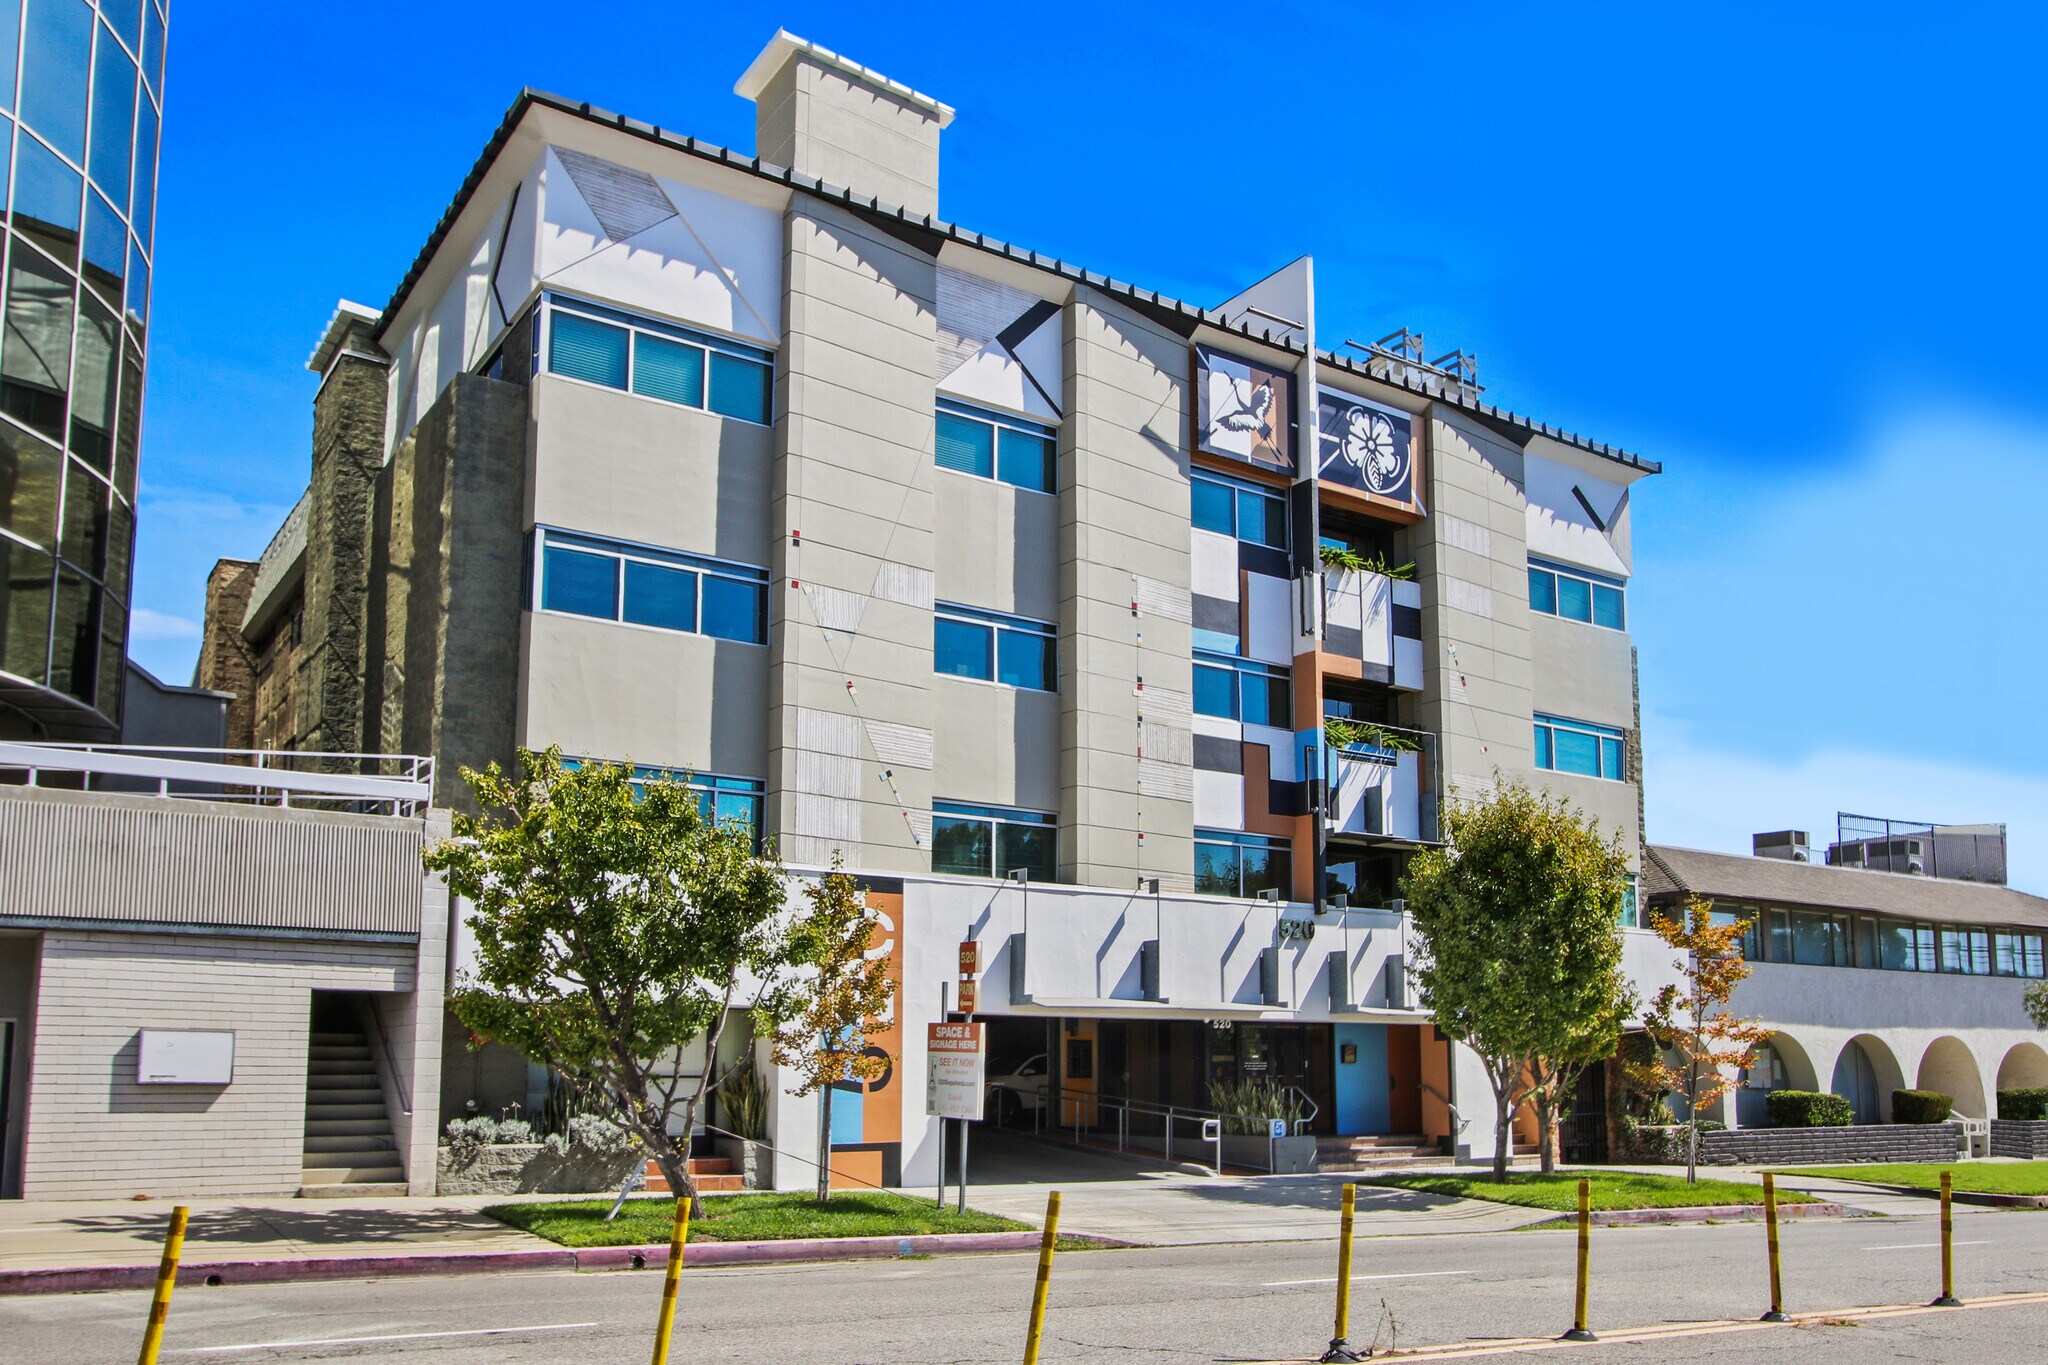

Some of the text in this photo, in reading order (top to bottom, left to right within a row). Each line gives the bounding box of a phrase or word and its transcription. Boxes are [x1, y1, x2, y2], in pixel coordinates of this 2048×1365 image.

[1279, 917, 1315, 939] 520
[961, 951, 975, 964] 520
[960, 983, 974, 995] PARK
[1213, 1019, 1231, 1029] 520
[936, 1026, 971, 1038] SPACE &
[929, 1039, 977, 1050] SIGNAGE HERE
[939, 1057, 976, 1068] SEE IT NOW
